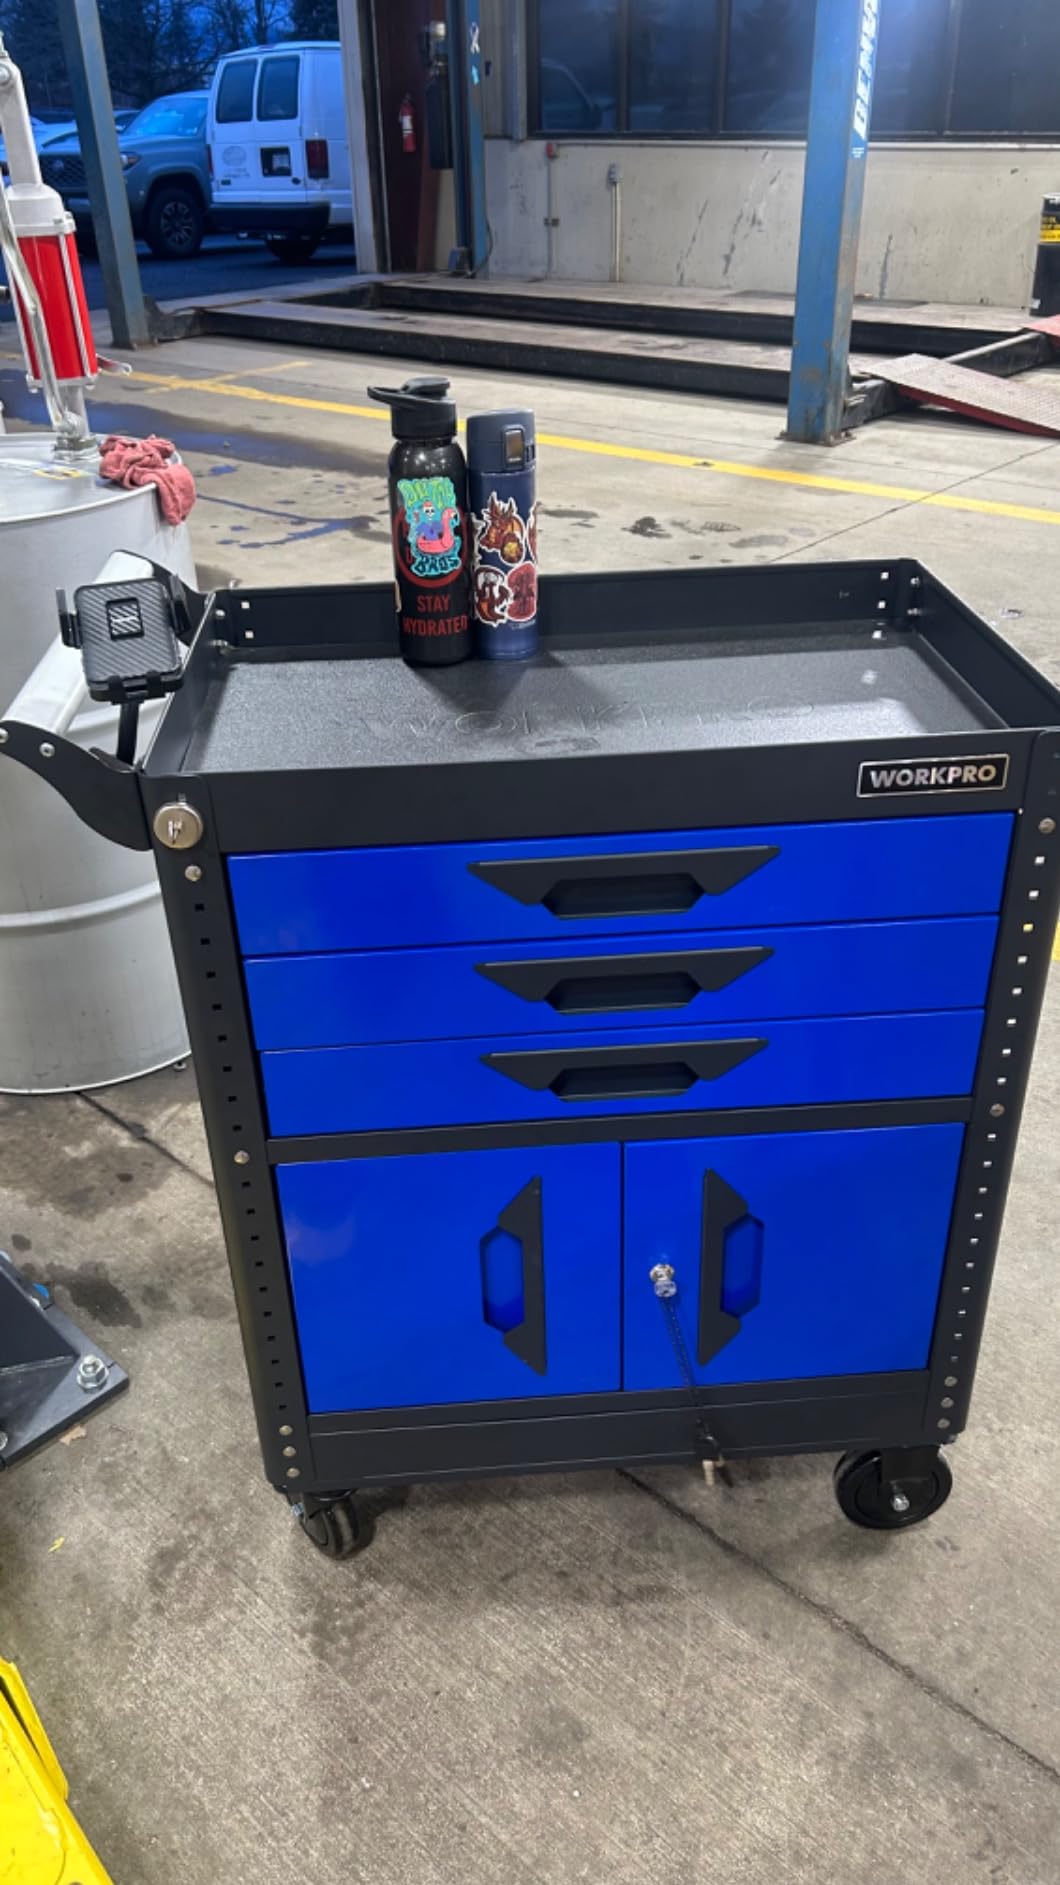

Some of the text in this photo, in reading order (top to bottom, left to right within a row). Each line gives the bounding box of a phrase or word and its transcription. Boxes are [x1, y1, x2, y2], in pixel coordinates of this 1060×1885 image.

[416, 594, 450, 612] STAY
[403, 614, 468, 636] HYDRATED
[870, 764, 997, 788] WORKPRO
